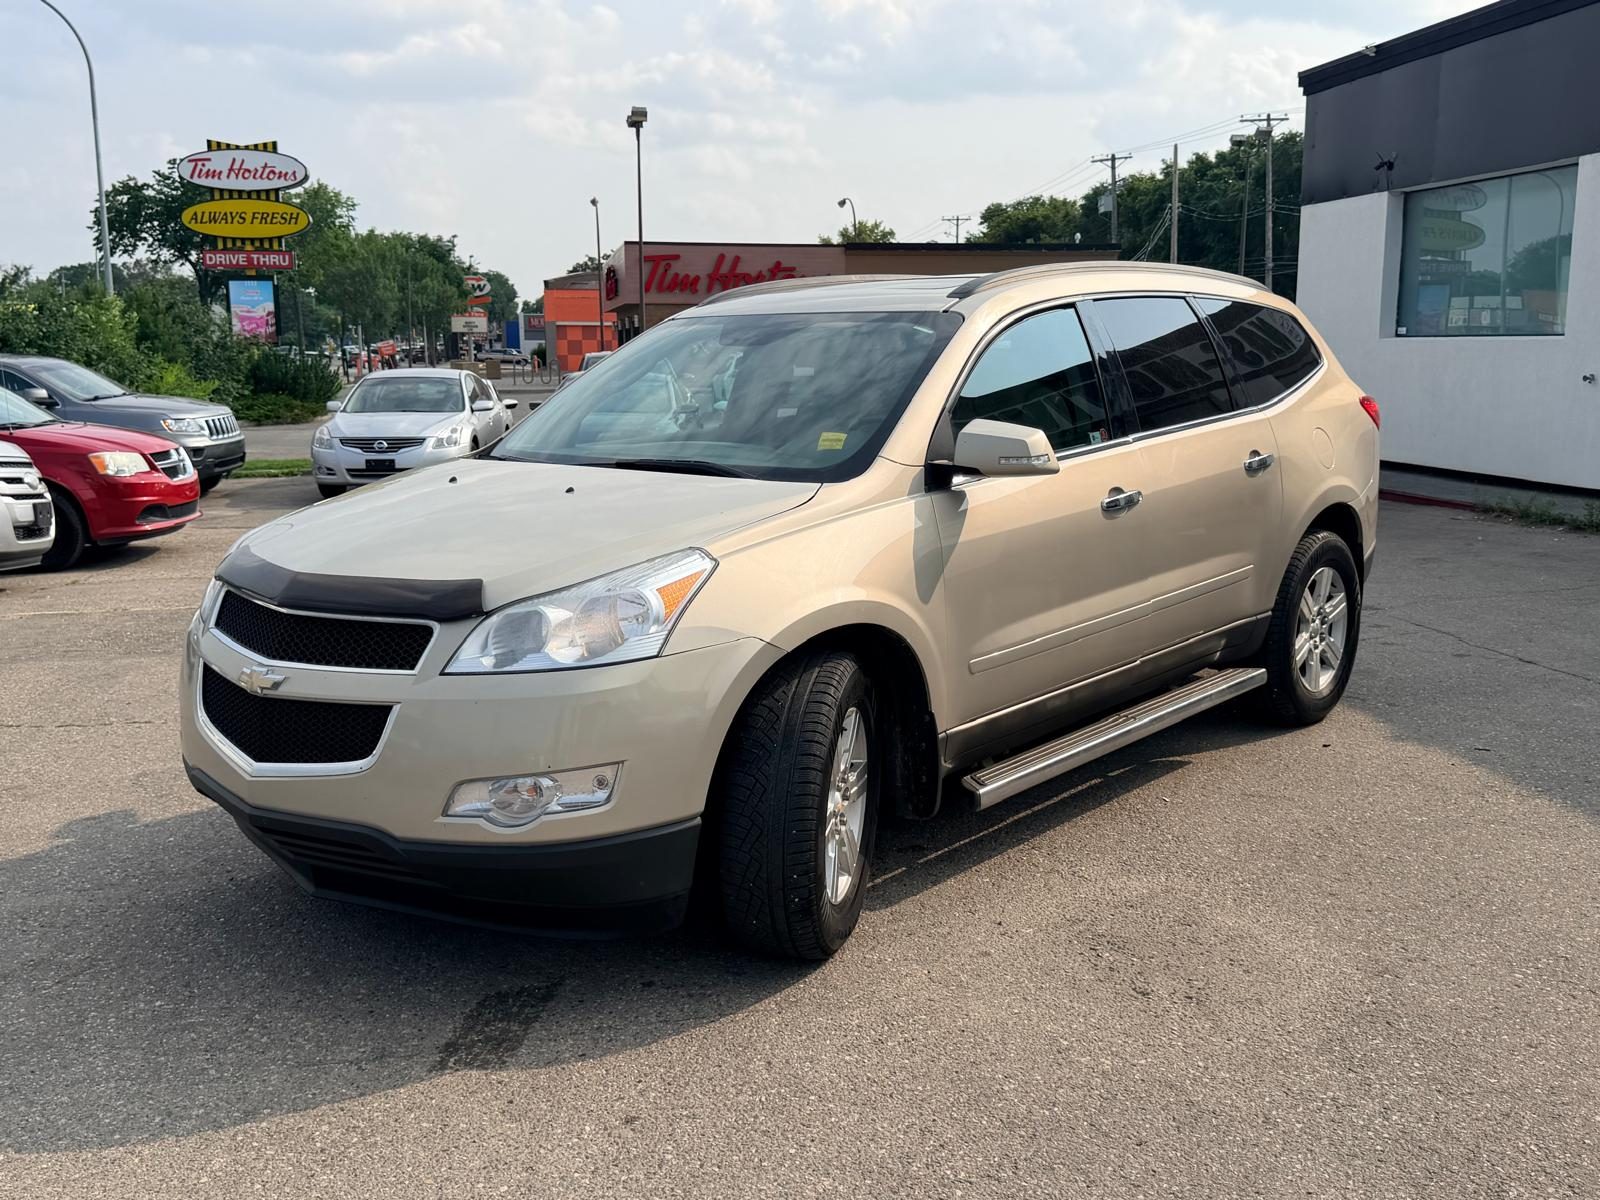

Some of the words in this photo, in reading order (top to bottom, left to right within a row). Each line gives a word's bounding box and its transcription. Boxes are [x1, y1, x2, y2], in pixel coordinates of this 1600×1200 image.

[187, 158, 223, 180] Tim
[226, 157, 298, 182] Hortons
[188, 211, 248, 225] ALWAYS
[250, 211, 301, 226] FRESH
[206, 253, 249, 266] DRIVE
[251, 254, 290, 266] THRU
[643, 254, 700, 294] Tim
[706, 253, 832, 294] Hort
